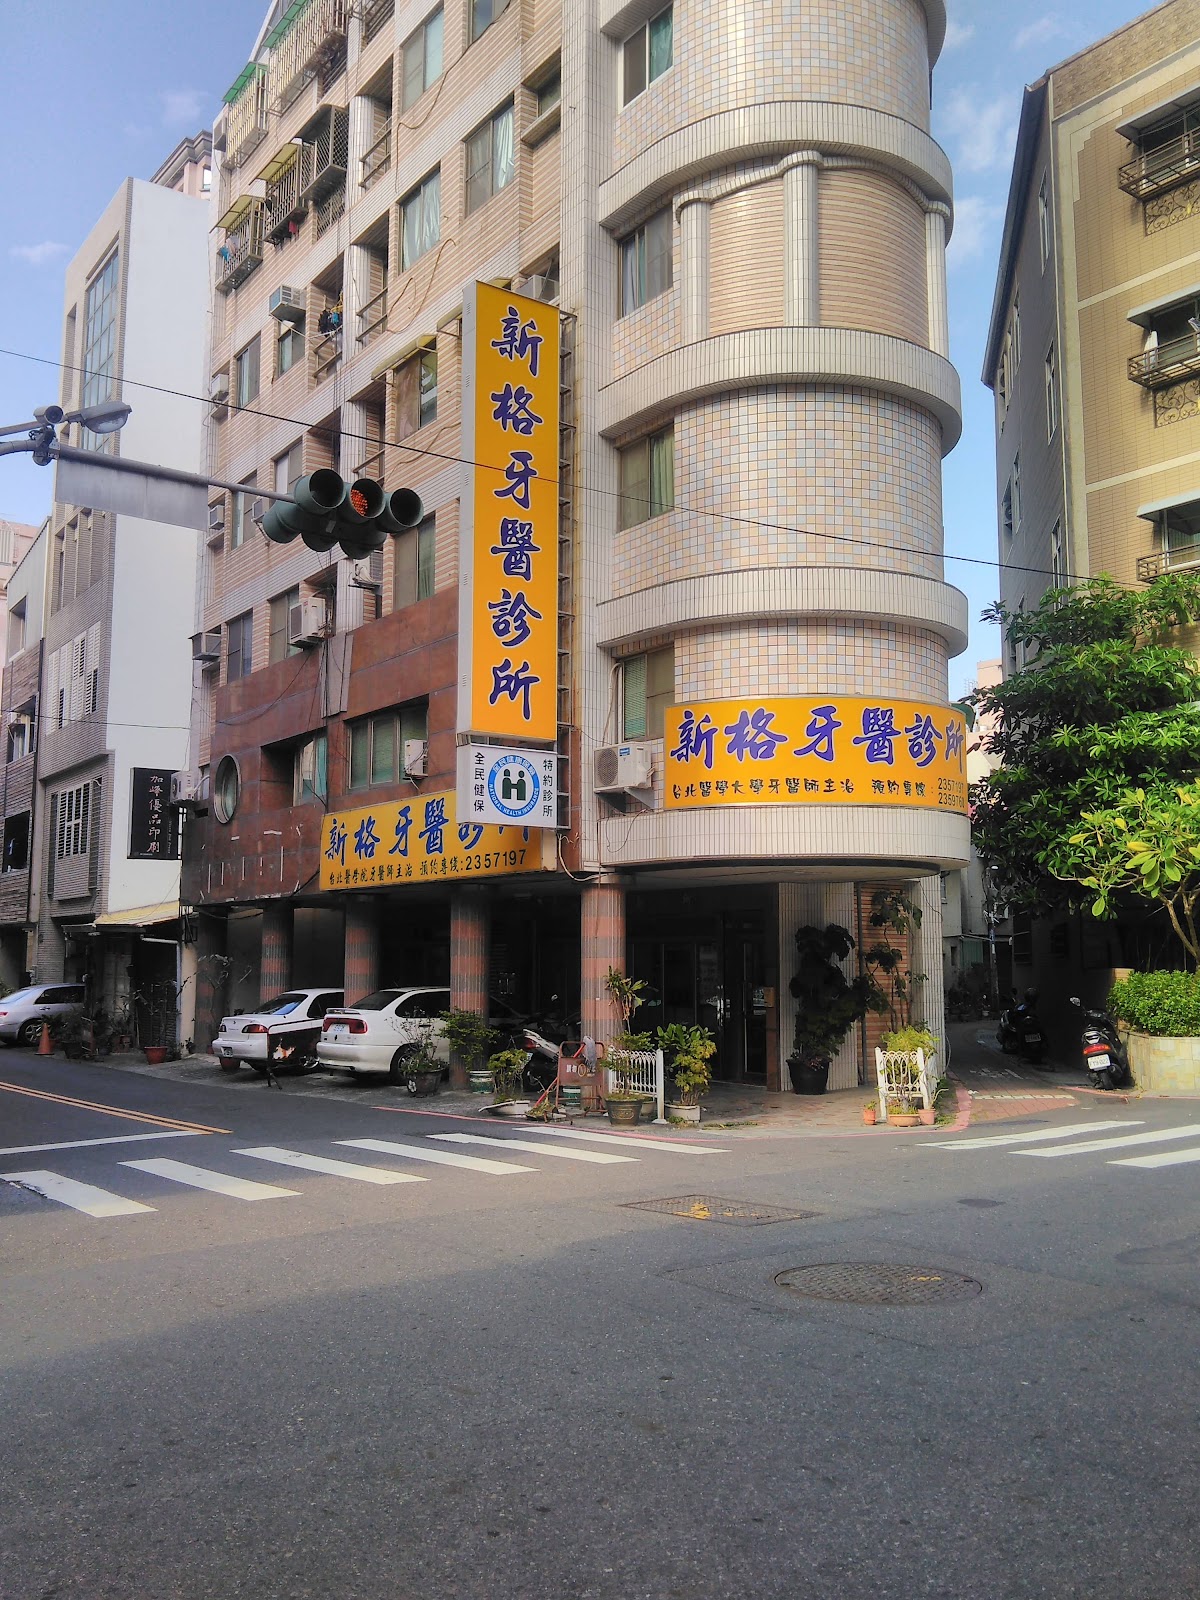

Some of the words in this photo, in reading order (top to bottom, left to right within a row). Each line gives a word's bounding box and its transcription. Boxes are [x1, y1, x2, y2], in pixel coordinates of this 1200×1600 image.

[488, 305, 544, 721] 新格牙醫診所
[670, 705, 965, 775] 新格牙醫診所
[473, 752, 485, 812] 全民健保
[542, 759, 553, 817] 特約診所
[672, 777, 855, 799] 台北醫學大學牙醫師主治
[937, 777, 964, 794] 2357197
[329, 863, 413, 885] 台北醫學院牙醫師主治
